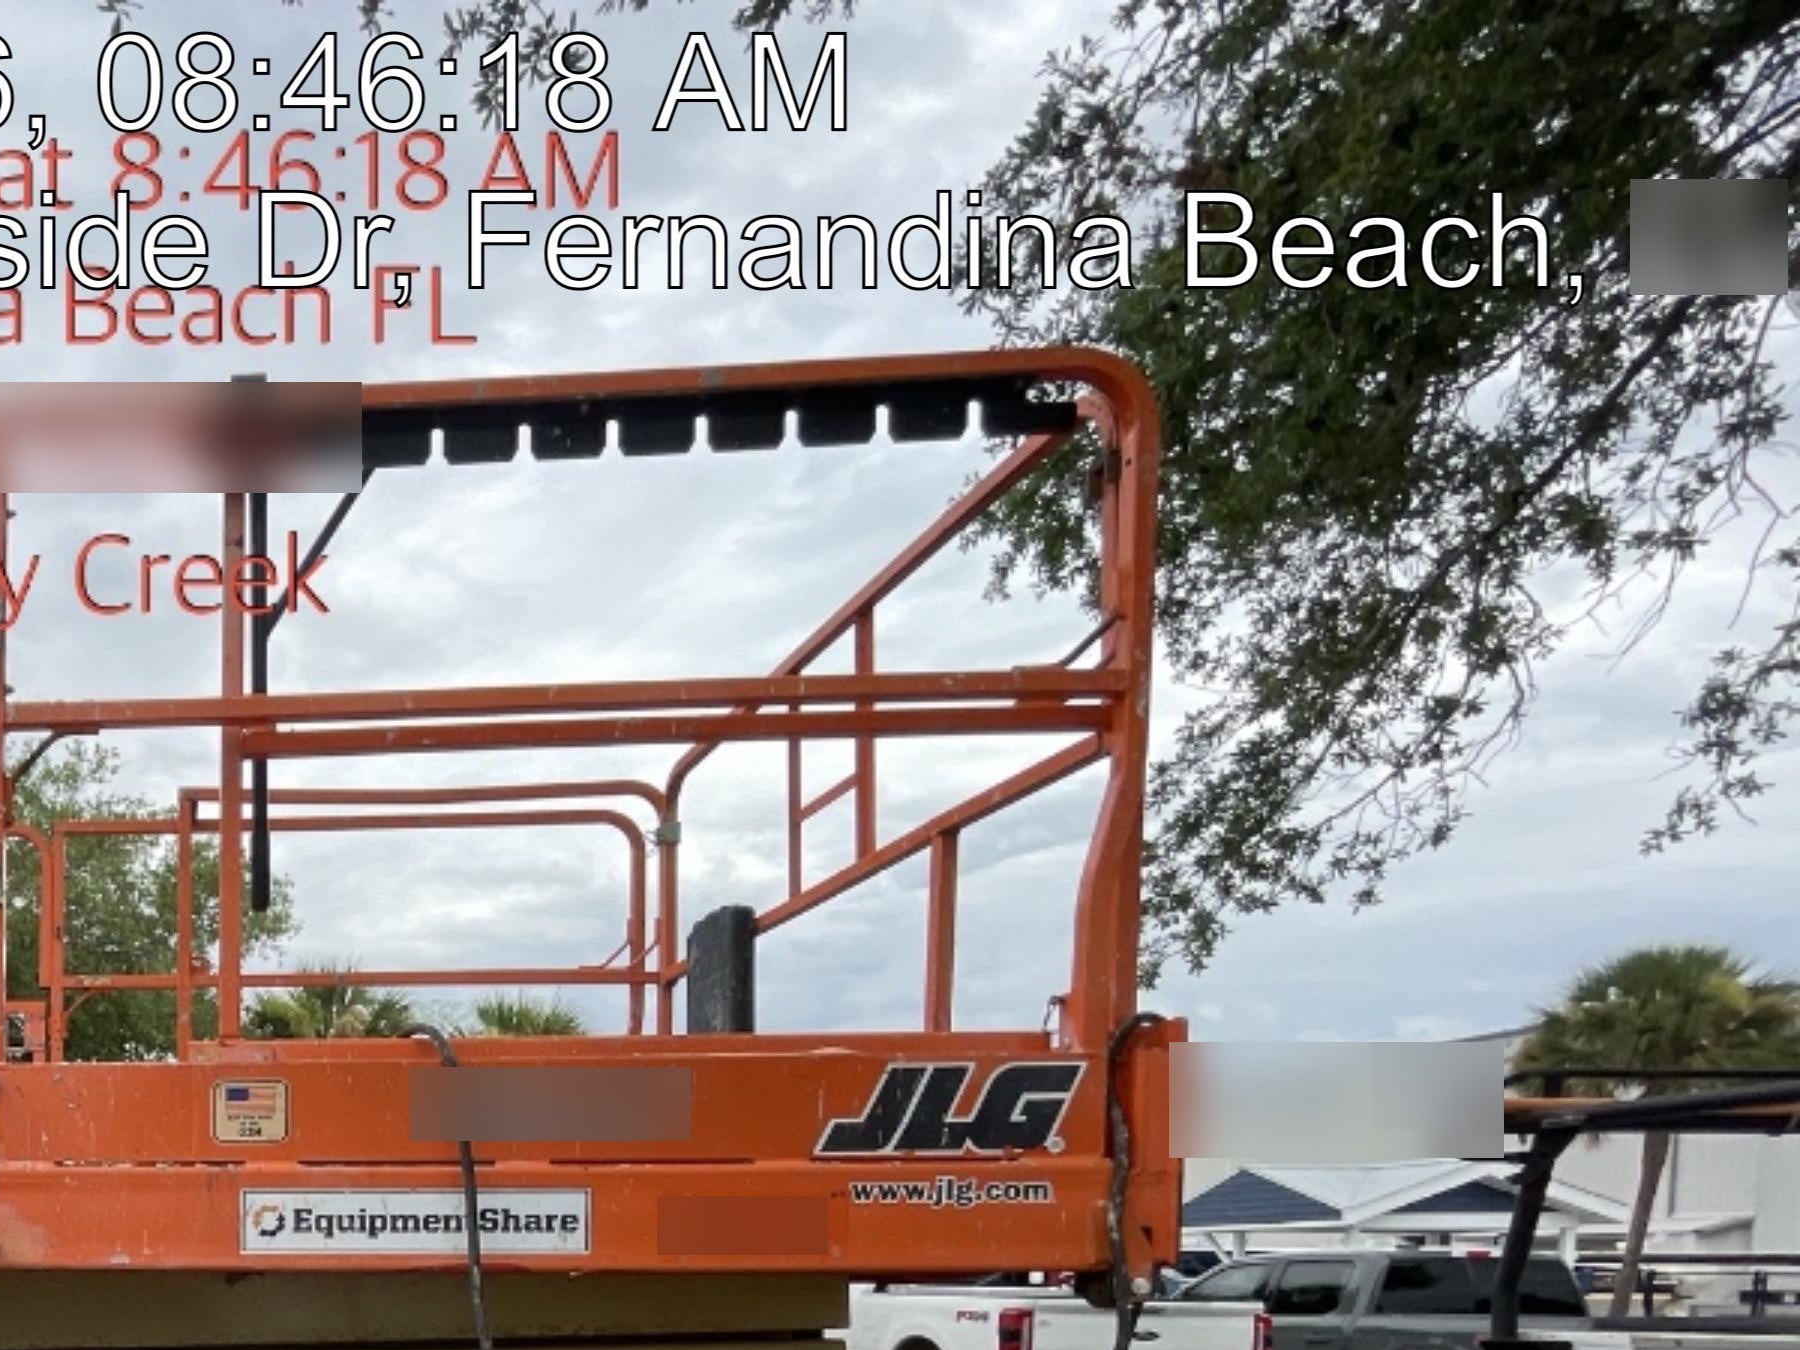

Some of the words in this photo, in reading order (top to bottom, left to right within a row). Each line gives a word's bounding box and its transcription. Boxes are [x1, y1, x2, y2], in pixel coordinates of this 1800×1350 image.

[812, 1062, 1088, 1156] JLG
[850, 1175, 1054, 1208] www.jlg.com
[293, 1208, 580, 1239] EquipmenShare
